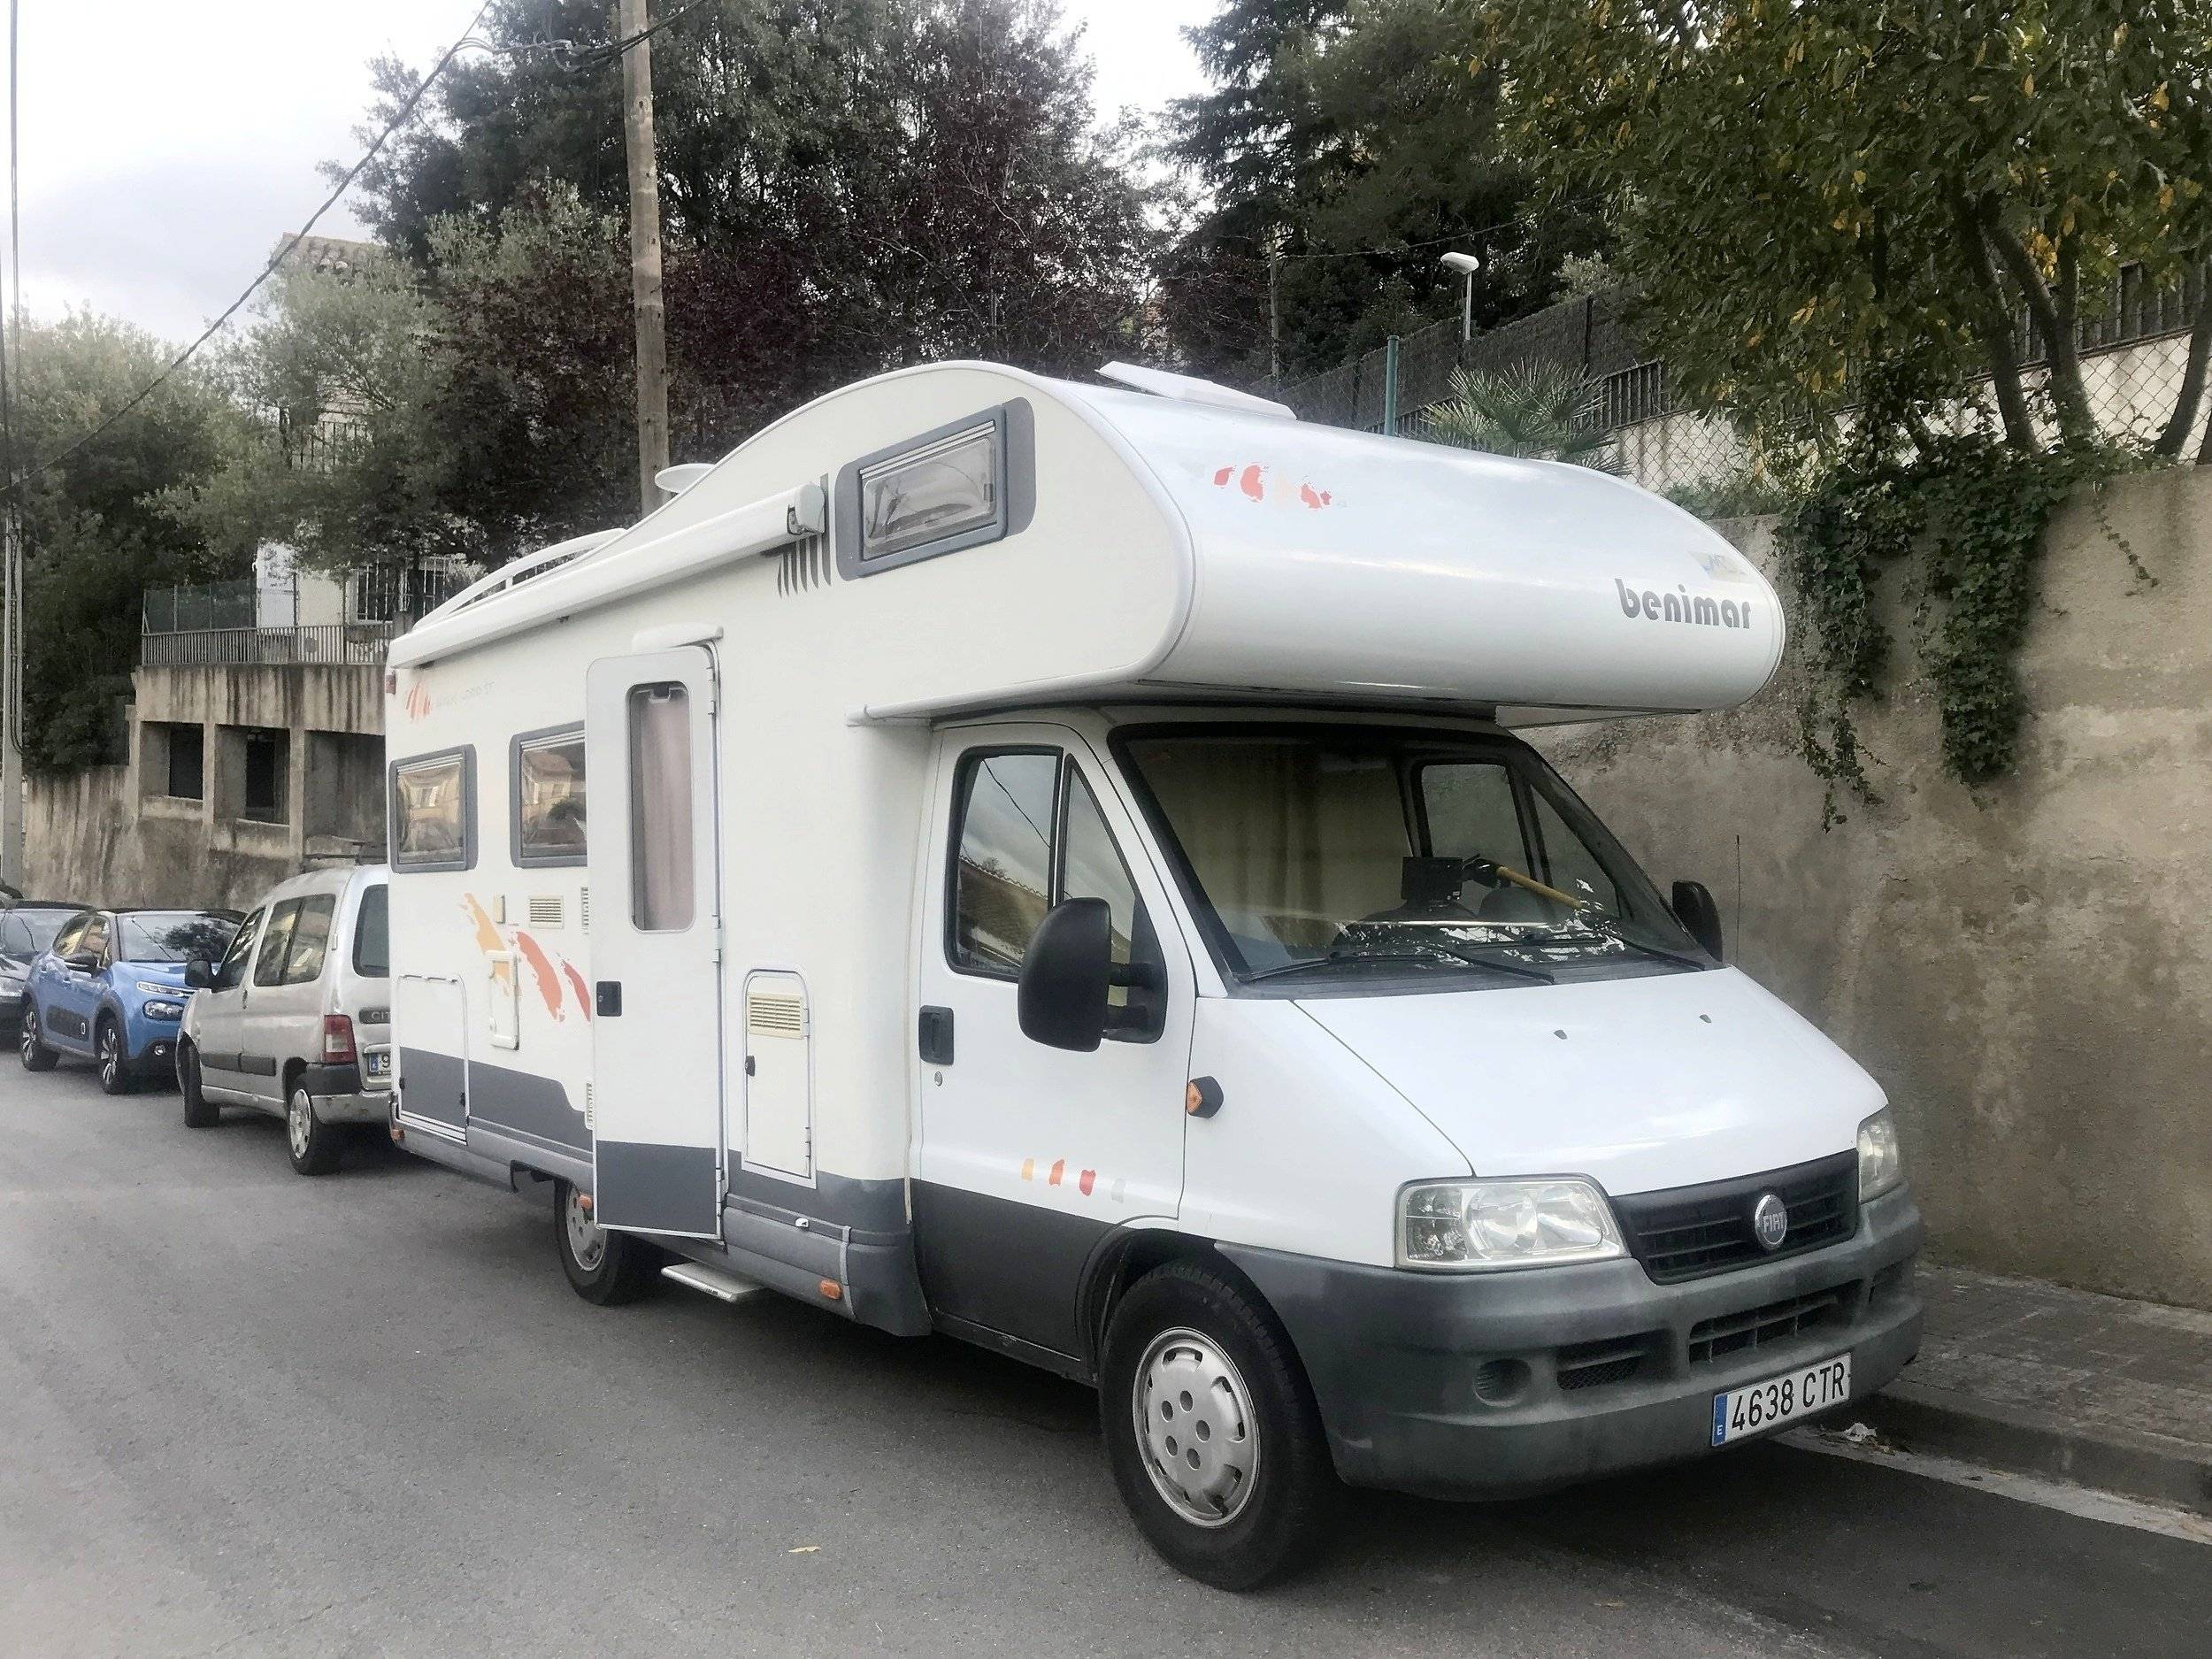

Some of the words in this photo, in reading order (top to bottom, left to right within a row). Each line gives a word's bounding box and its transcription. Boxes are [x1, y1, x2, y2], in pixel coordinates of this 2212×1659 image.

[1614, 578, 1751, 629] benimar
[1763, 1212, 1786, 1233] FIAT
[1717, 1425, 1724, 1435] E
[1732, 1379, 1794, 1431] 4638
[1802, 1362, 1845, 1408] CTR
